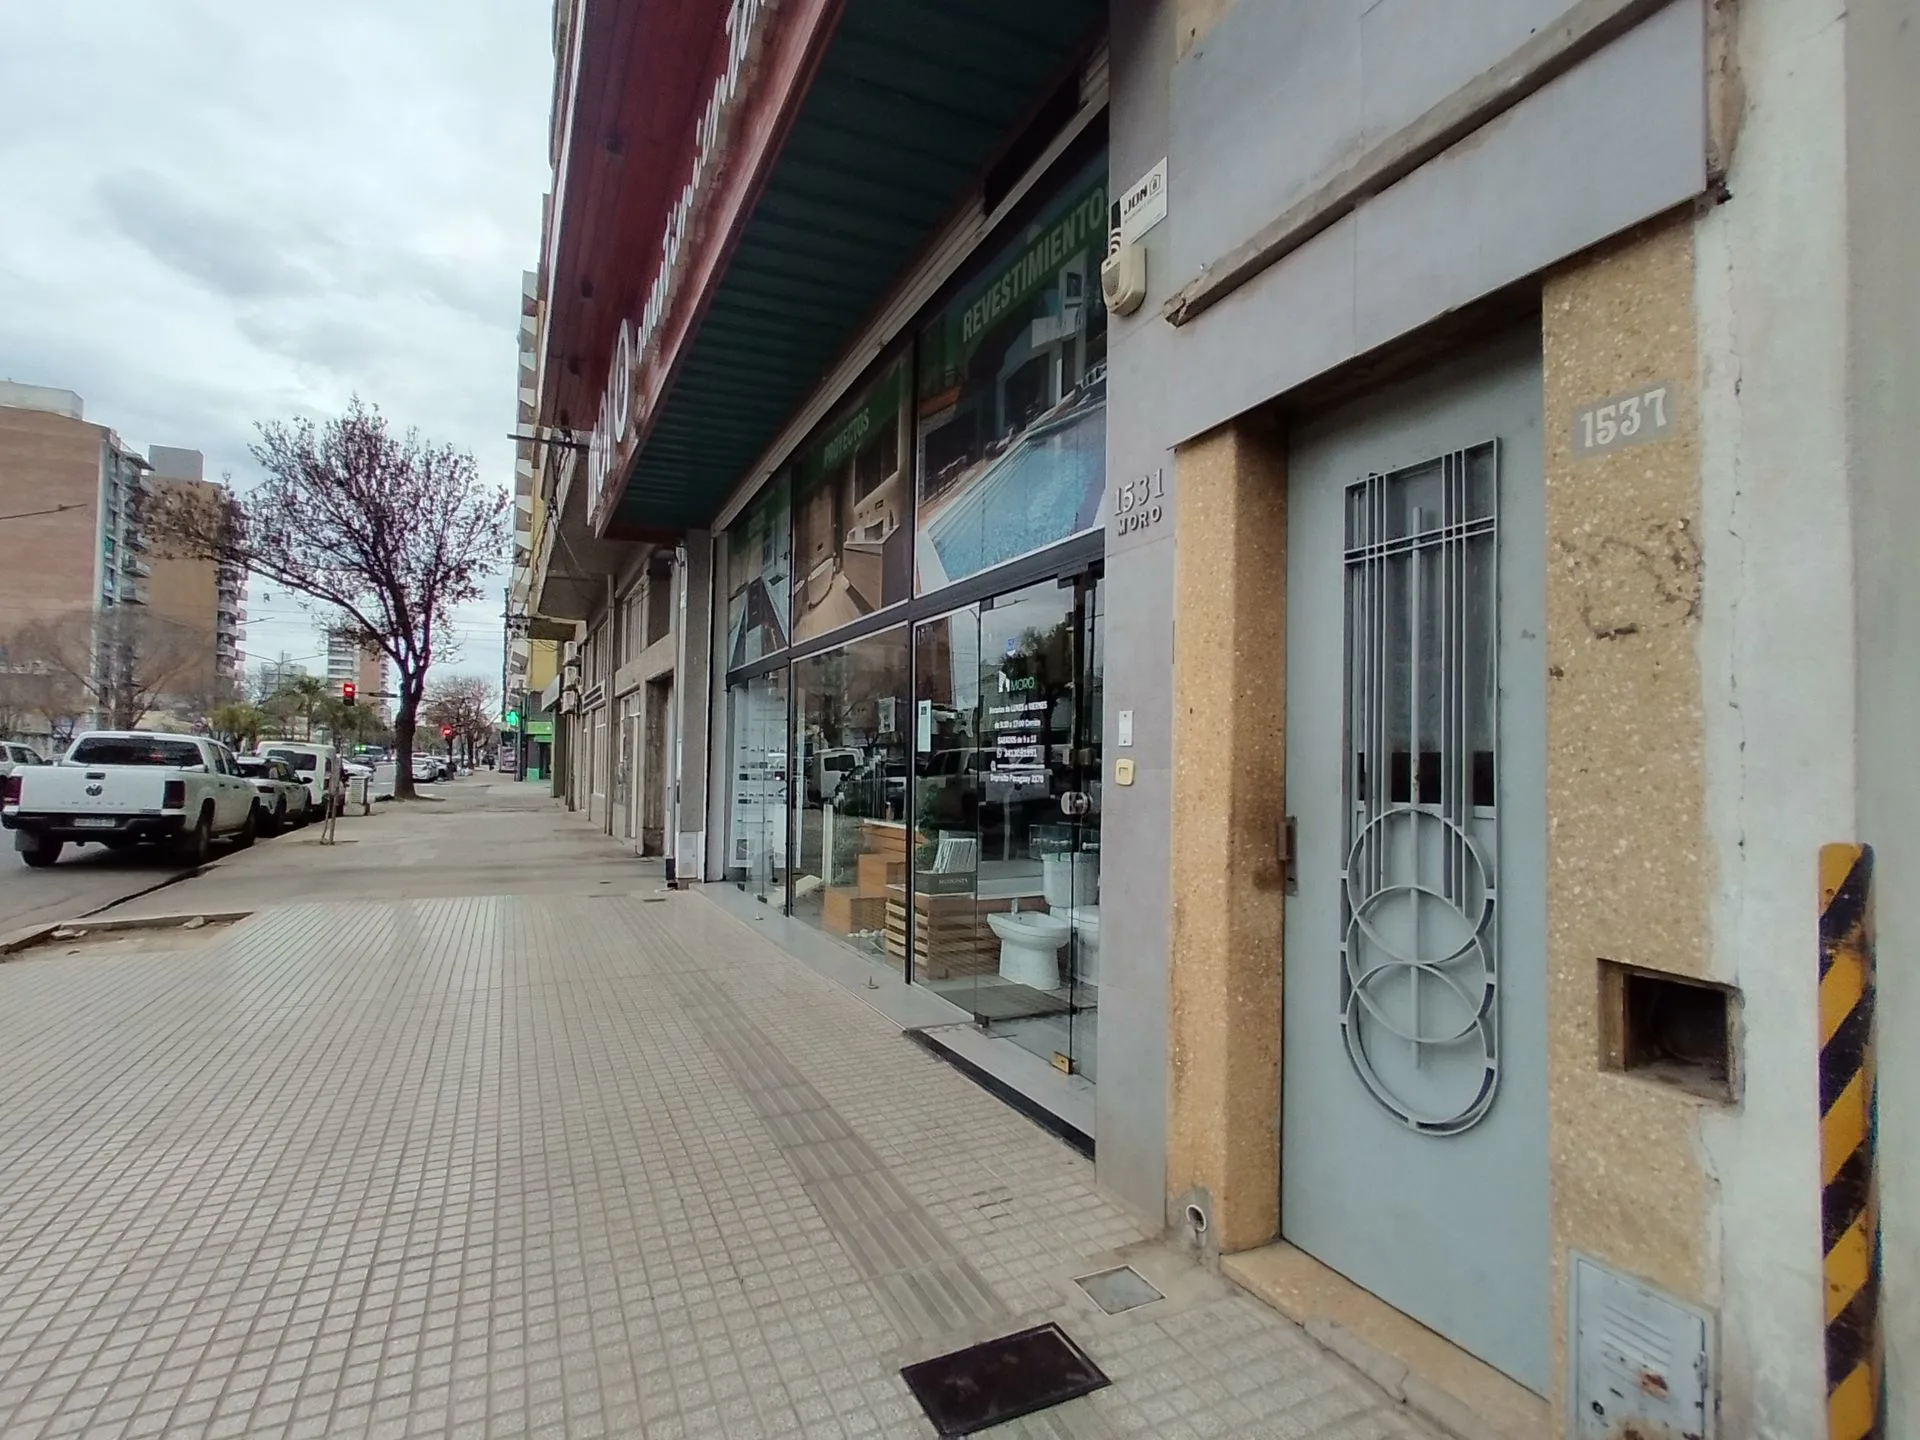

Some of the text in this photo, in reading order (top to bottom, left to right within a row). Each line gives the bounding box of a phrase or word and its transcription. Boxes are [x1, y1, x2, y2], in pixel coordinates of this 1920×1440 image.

[1123, 185, 1148, 216] JON
[963, 184, 1109, 343] REVESTIMIENTO
[1581, 387, 1667, 448] 1537
[1114, 468, 1165, 517] 1531
[1118, 506, 1163, 537] MORO
[1010, 676, 1035, 691] MORO
